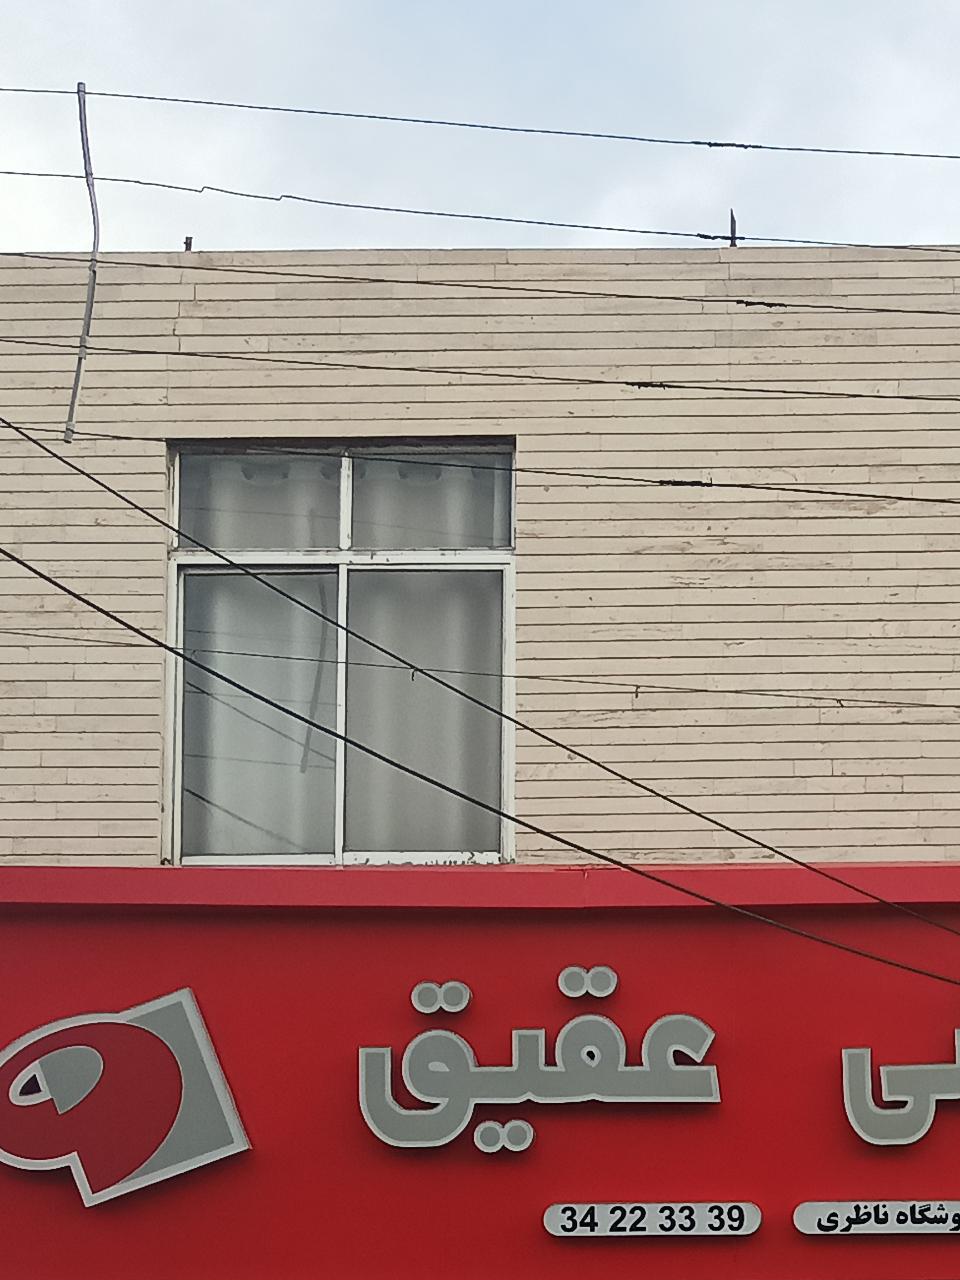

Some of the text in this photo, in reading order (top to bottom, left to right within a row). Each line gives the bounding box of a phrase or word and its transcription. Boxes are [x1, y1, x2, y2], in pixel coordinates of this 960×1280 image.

[358, 964, 721, 1153] عقیق
[559, 1204, 745, 1233] 34 22 33 39
[816, 1203, 889, 1233] ناظری
